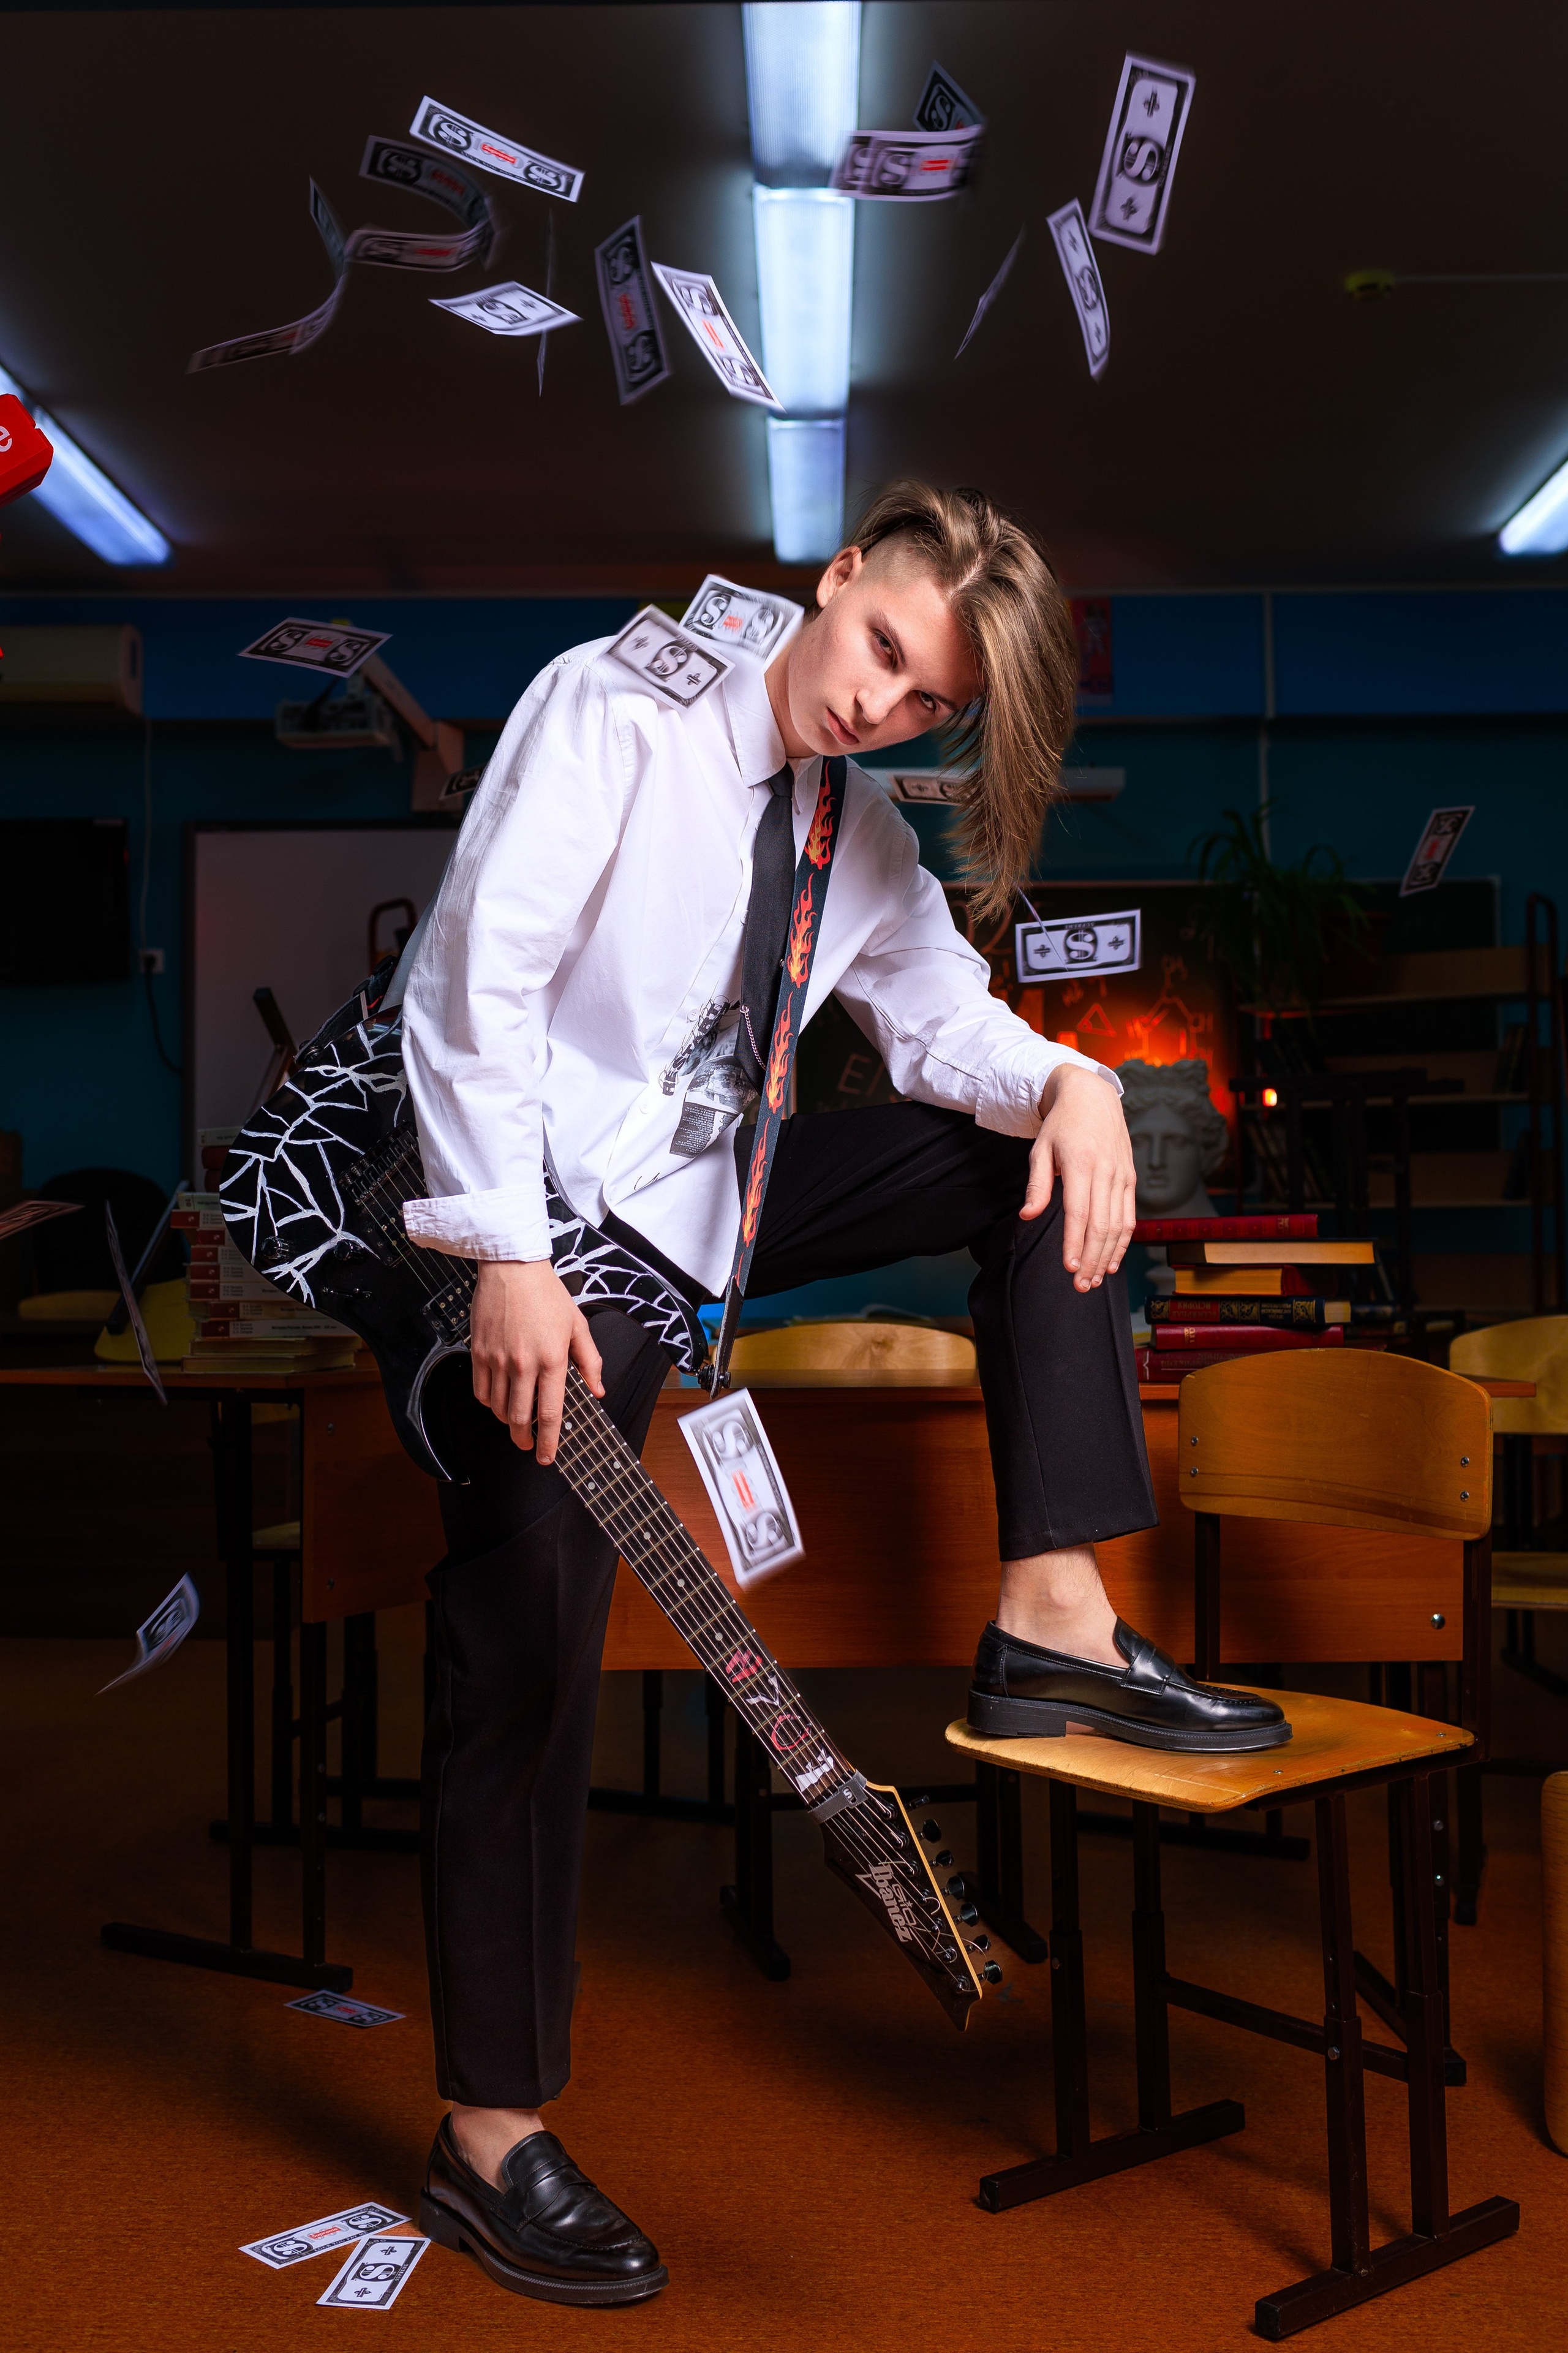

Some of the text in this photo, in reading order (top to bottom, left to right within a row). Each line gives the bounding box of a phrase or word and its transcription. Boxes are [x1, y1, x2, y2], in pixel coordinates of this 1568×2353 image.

[1177, 1301, 1212, 1310] ИСТОРИЯ
[868, 1863, 913, 1943] Ibanez
[311, 2227, 339, 2238] Supreme
[394, 2264, 409, 2281] SUPREME
